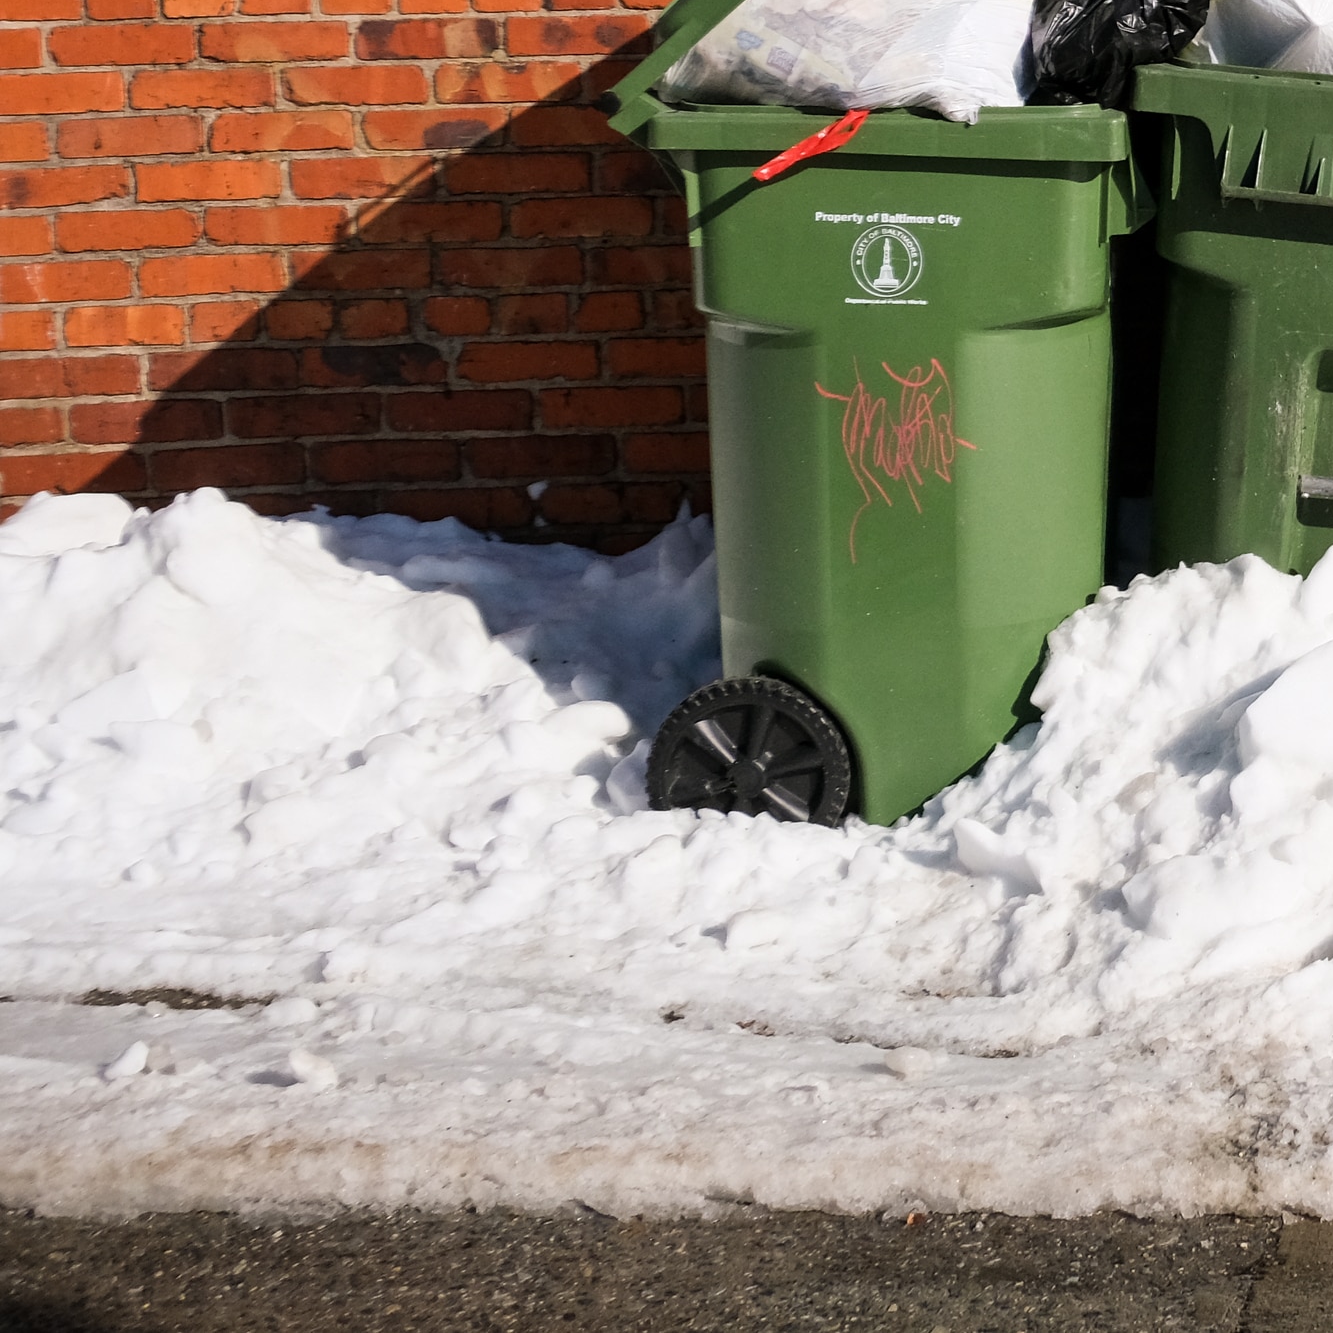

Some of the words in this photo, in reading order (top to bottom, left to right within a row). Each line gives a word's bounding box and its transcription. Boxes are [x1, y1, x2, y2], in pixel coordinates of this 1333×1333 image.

[815, 211, 863, 225] Property
[866, 213, 879, 224] of
[881, 213, 936, 225] Baltimore
[937, 214, 962, 227] City
[855, 237, 870, 257] CITY
[868, 228, 881, 240] OF
[881, 227, 919, 259] BALTIMORE
